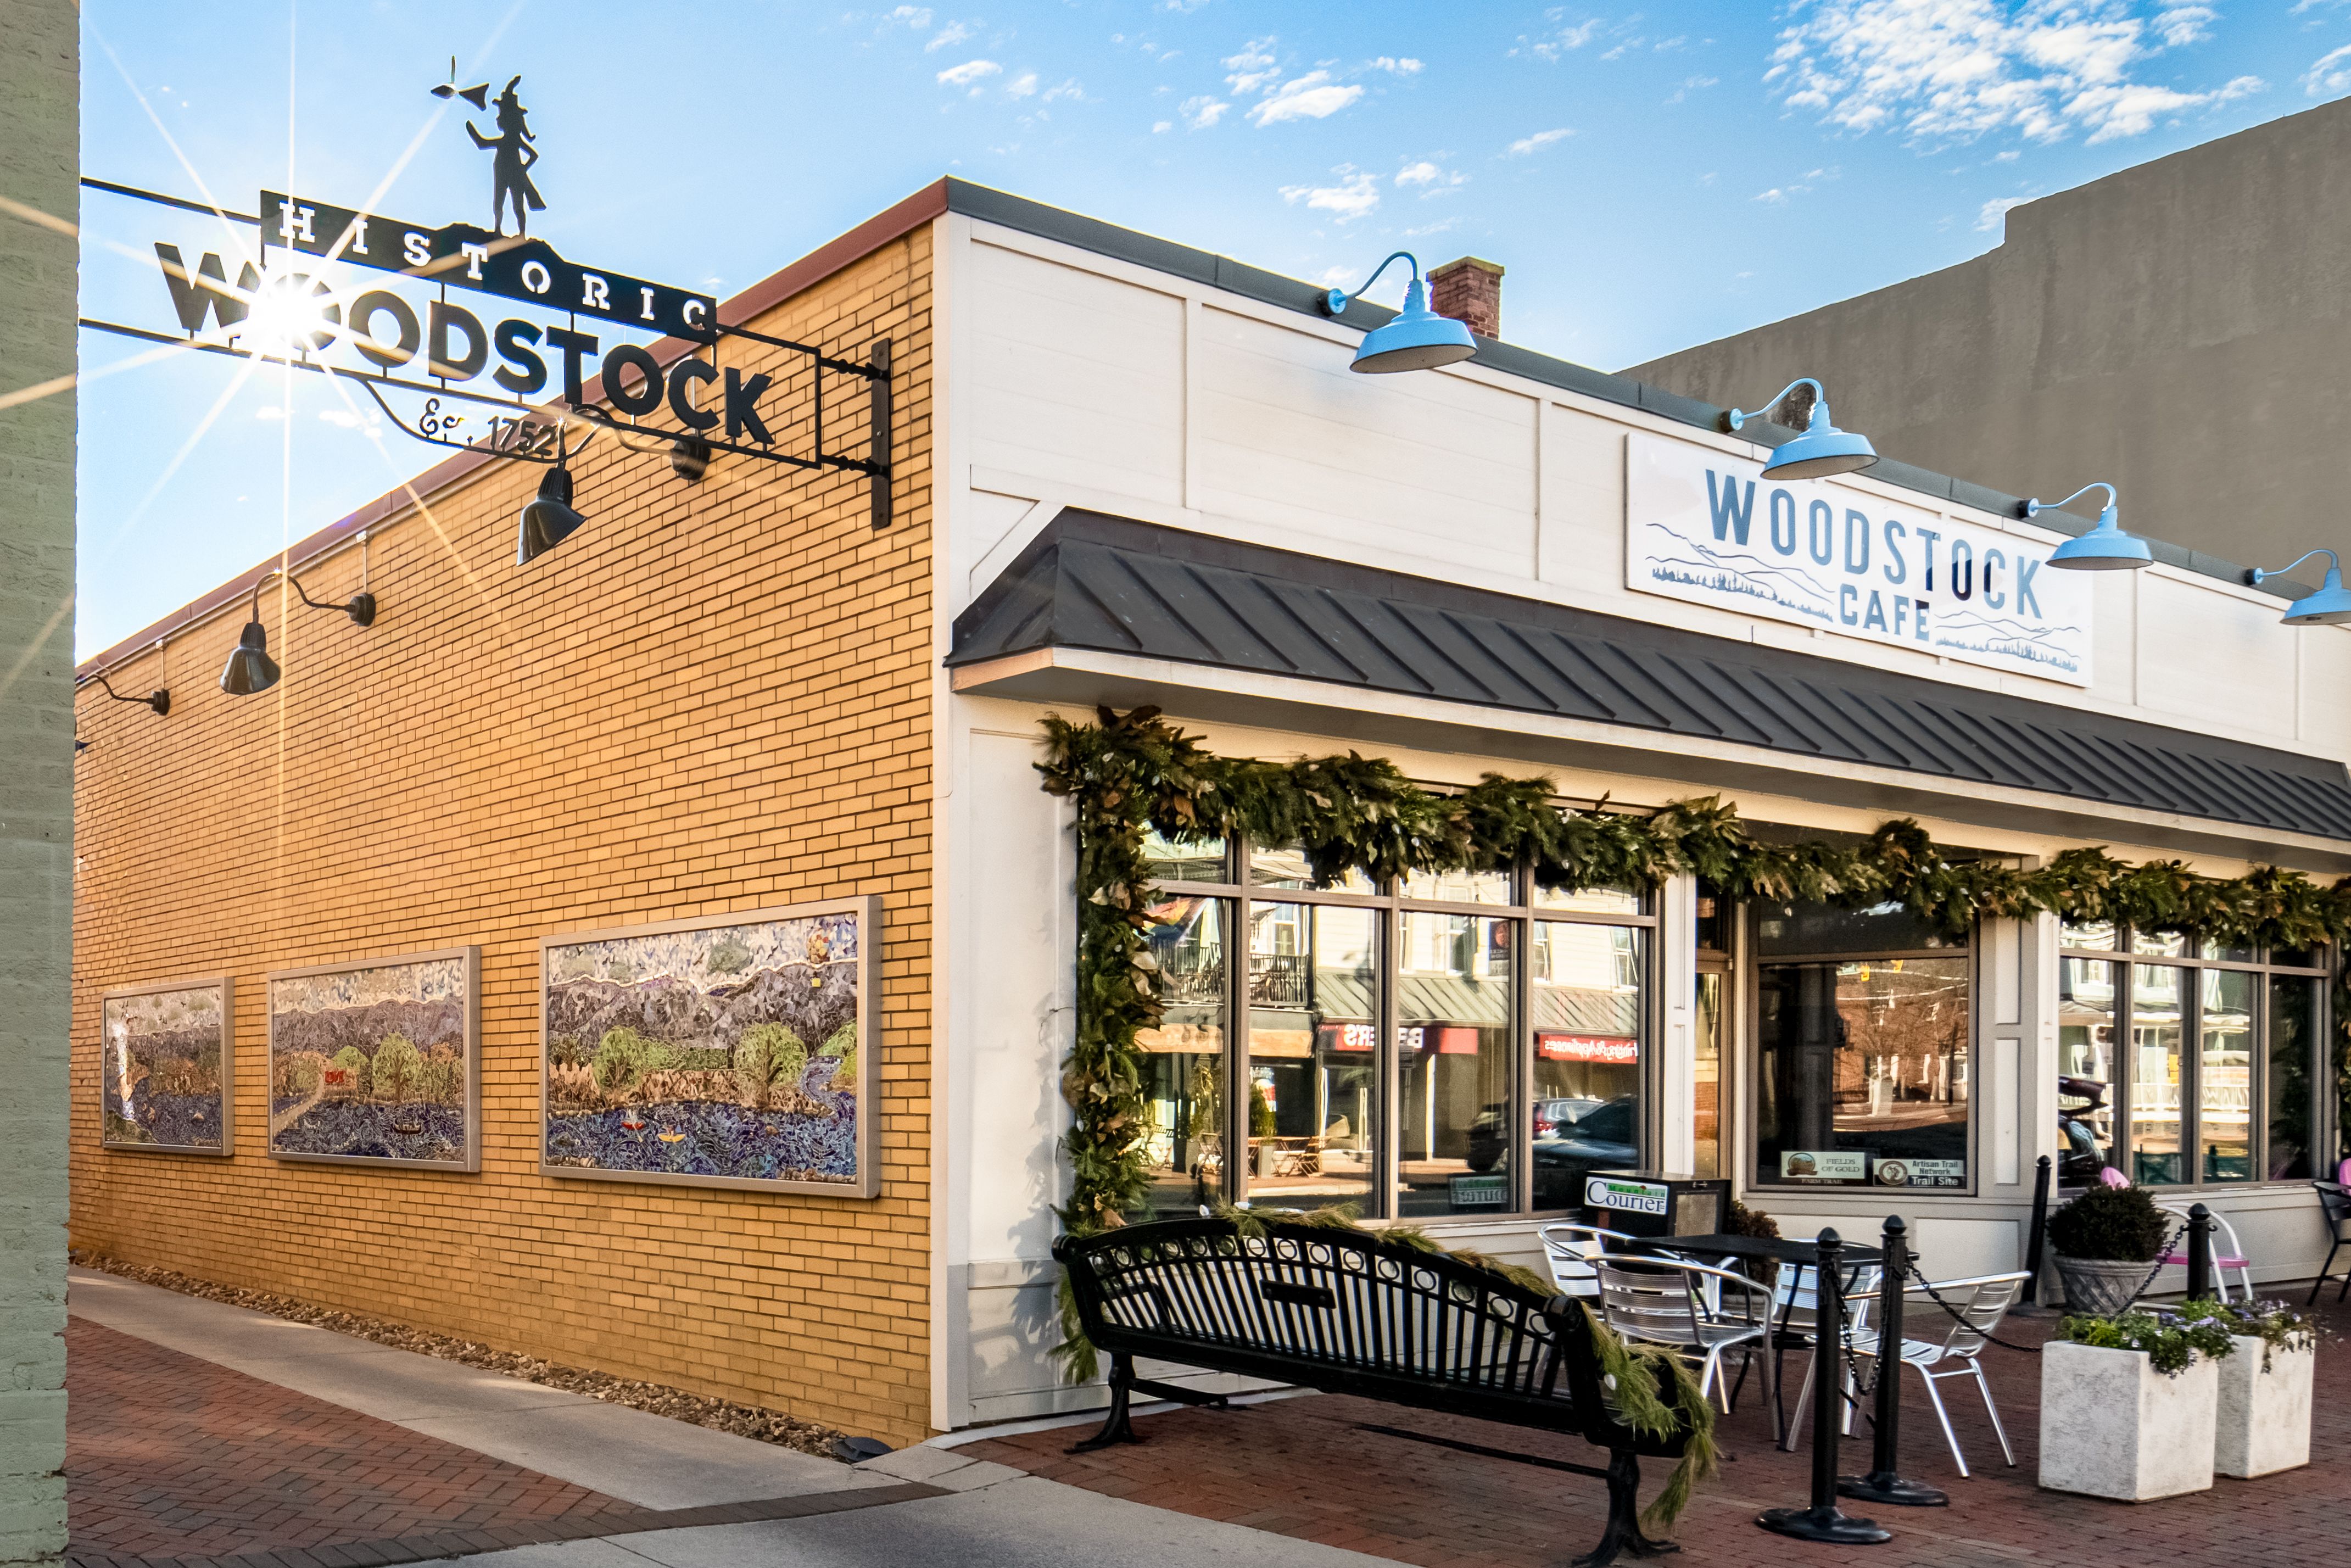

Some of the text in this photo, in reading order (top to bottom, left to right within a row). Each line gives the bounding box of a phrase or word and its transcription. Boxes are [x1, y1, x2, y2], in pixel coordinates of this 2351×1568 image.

[279, 201, 706, 331] HISTORIC
[487, 415, 559, 456] 1752
[1705, 468, 2042, 620] WOODSTOCK
[1840, 583, 1930, 642] CAFE
[1587, 1180, 1664, 1212] Courier
[1911, 1176, 1958, 1186] Trail Site
